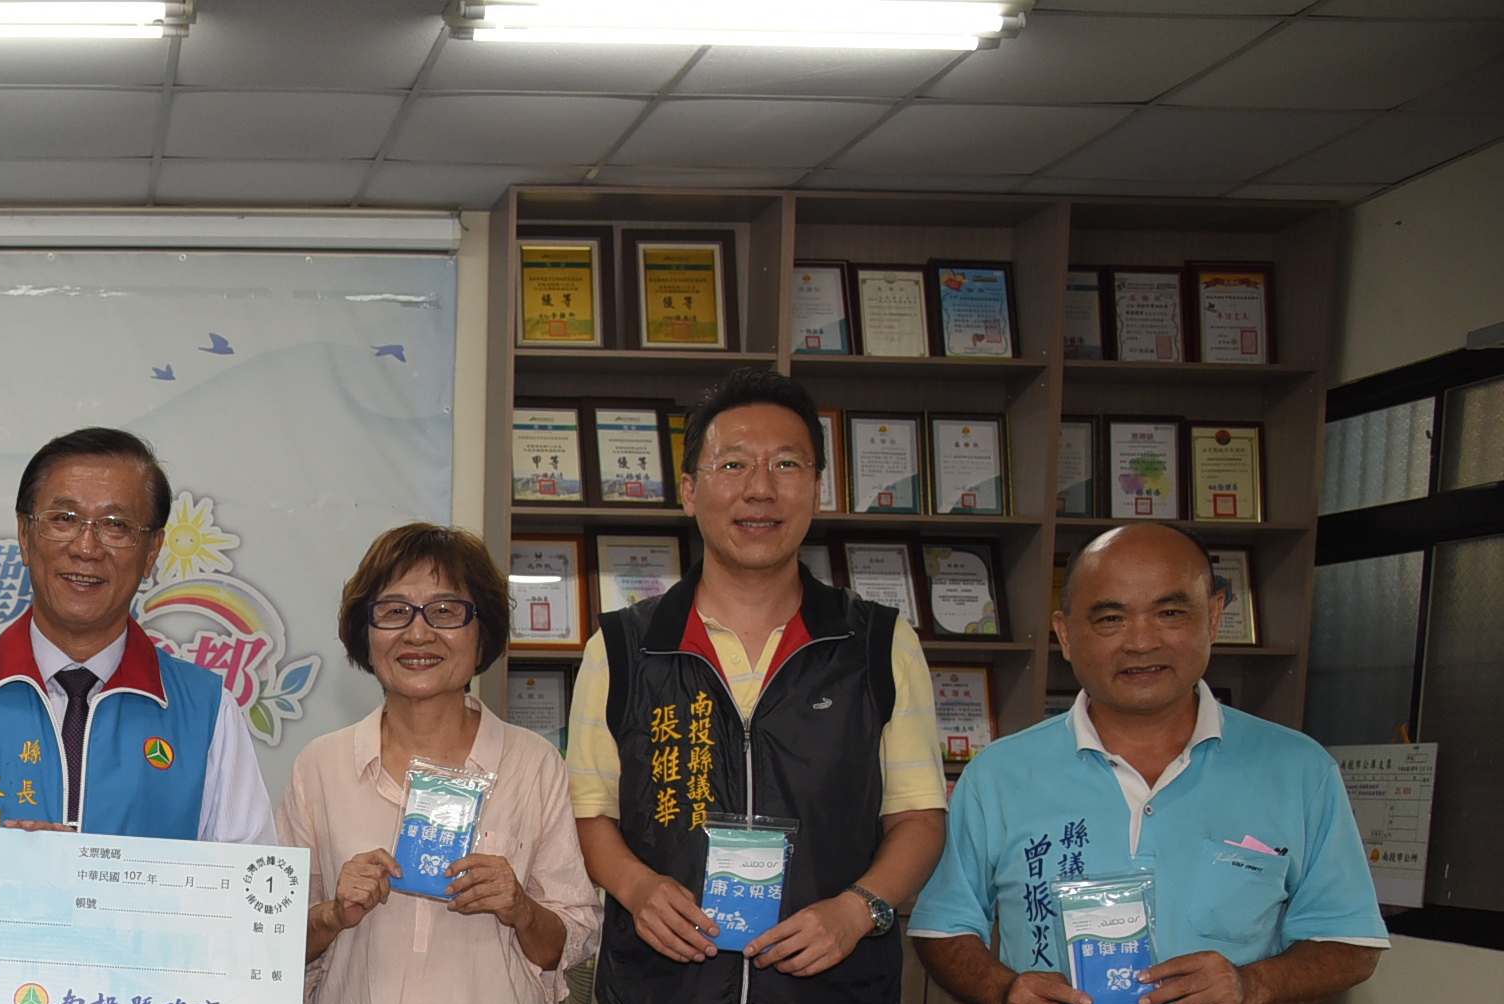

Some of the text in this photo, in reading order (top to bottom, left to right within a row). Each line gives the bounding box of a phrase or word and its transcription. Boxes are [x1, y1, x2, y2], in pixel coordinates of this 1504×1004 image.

[651, 703, 683, 828] 張維華
[686, 690, 716, 831] 南投縣議員
[16, 739, 43, 806] 縣長
[78, 845, 122, 861] 支票號碼
[77, 869, 231, 890] 中華民國 107 年 月 日
[265, 876, 274, 894] 1
[75, 896, 98, 910] 帳號
[1023, 833, 1059, 968] 曾振炎
[250, 968, 283, 982] 記帳
